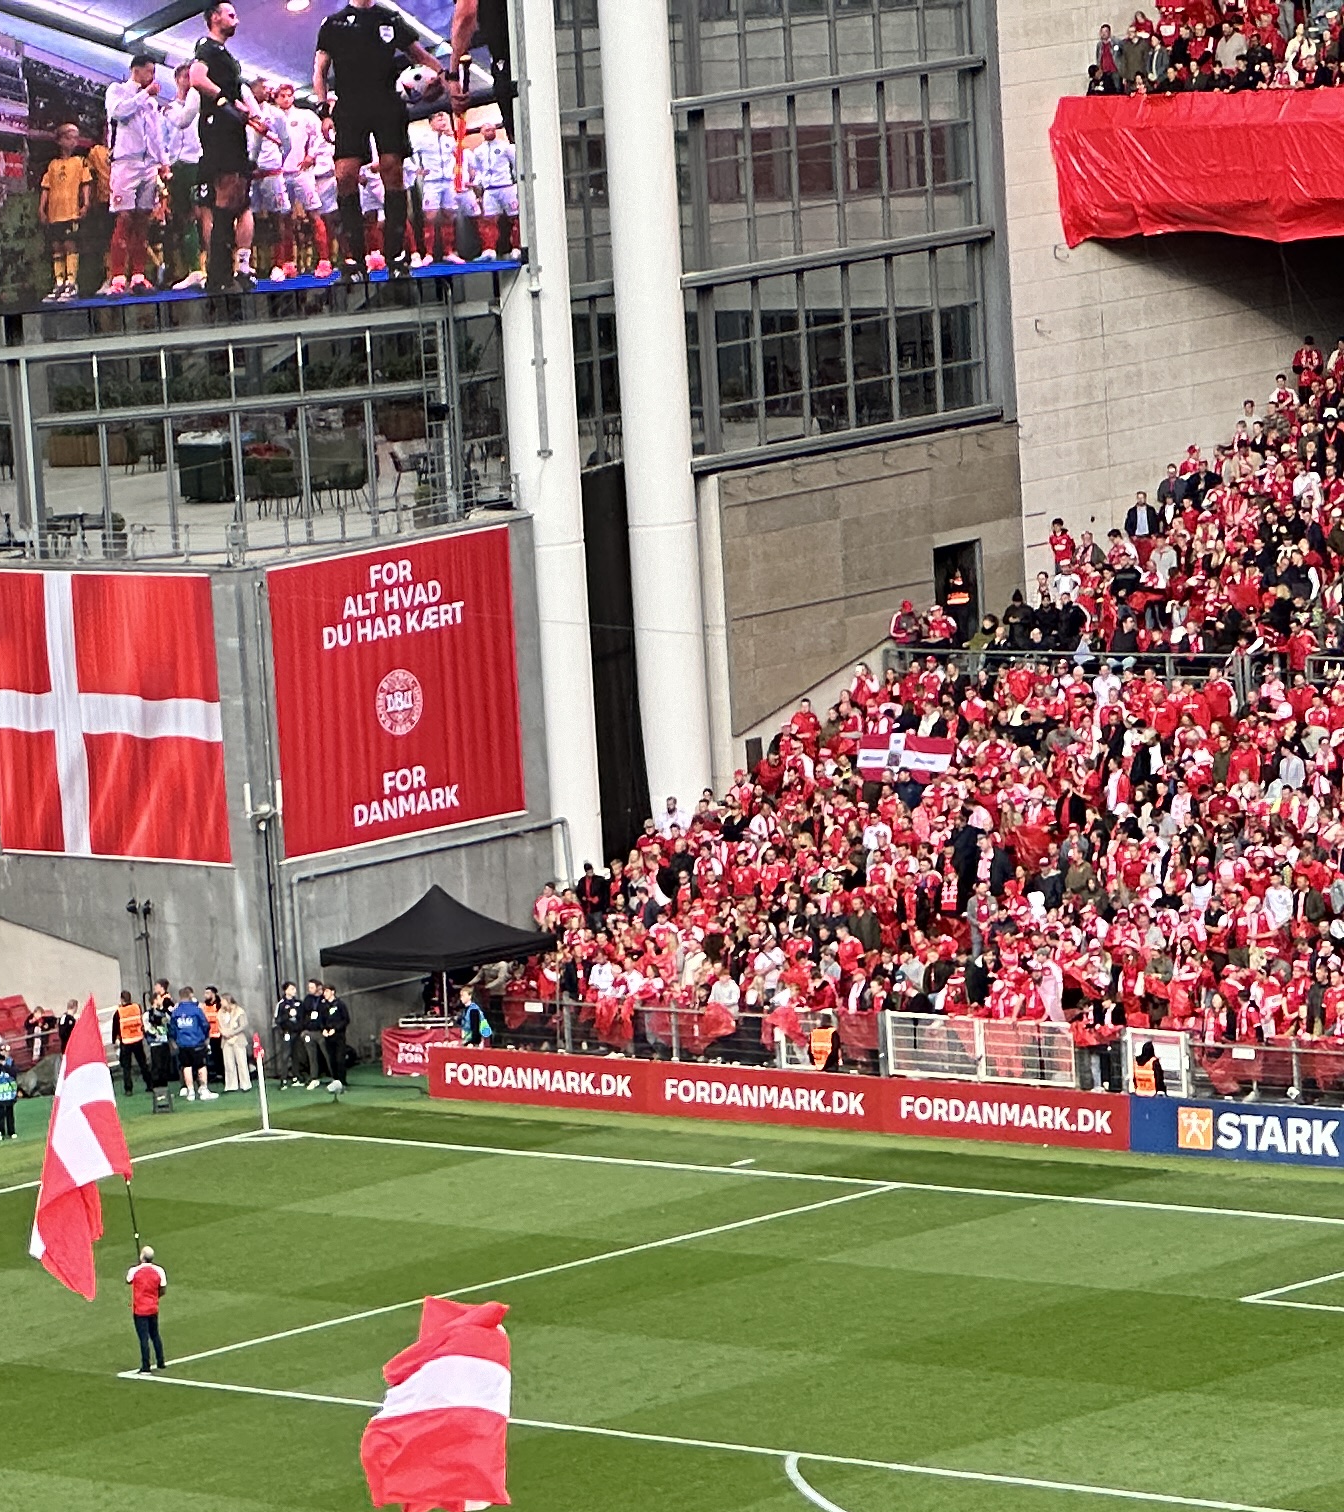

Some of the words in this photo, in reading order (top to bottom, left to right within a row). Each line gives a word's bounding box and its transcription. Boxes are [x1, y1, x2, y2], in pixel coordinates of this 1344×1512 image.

[369, 558, 413, 588] FOR
[342, 591, 379, 620] ALT
[384, 579, 442, 612] HVAD
[322, 623, 352, 650] DU
[356, 613, 402, 644] HAR
[405, 601, 465, 634] KÆRT
[383, 764, 427, 795] FOR
[353, 784, 461, 828] DANMARK
[444, 1062, 633, 1099] FORDANMARK.DK
[664, 1077, 865, 1116] FORDANMARK.DK
[900, 1095, 1112, 1135] FORDANMARK.DK
[1216, 1111, 1340, 1158] STARK
